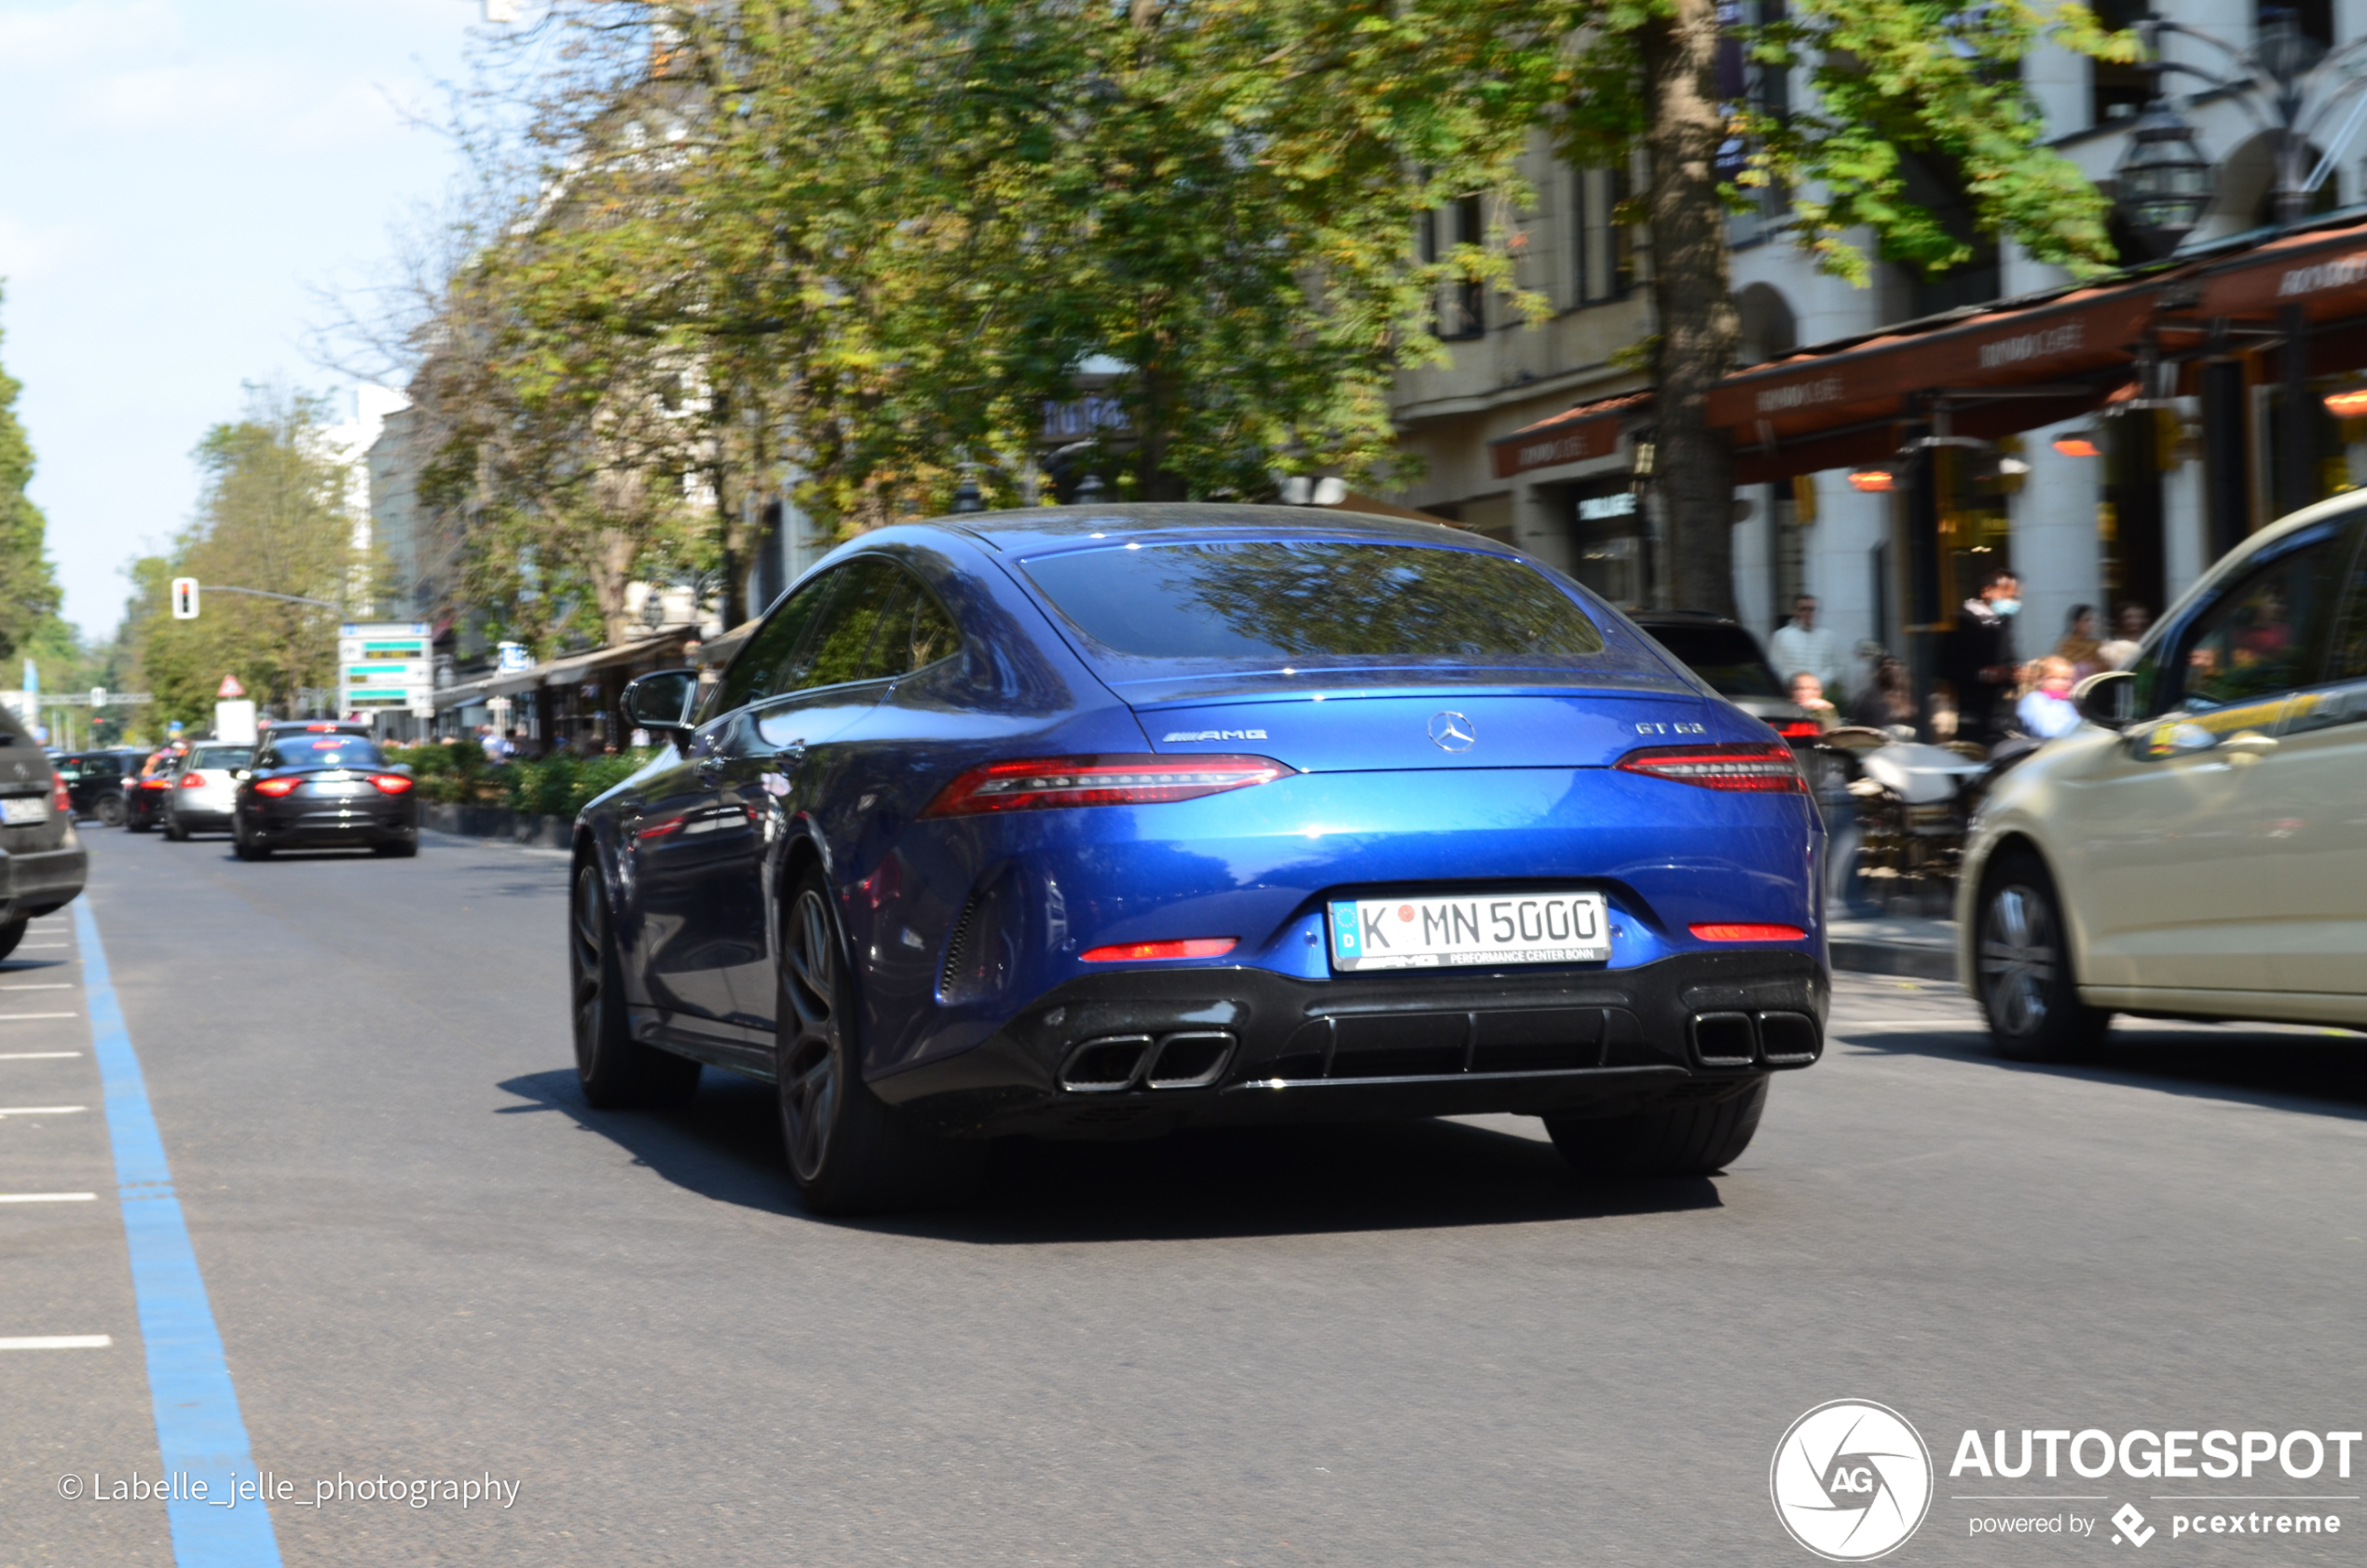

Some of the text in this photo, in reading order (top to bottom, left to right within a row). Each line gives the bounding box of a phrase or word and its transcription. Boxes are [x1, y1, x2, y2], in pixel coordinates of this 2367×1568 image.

[1193, 729, 1268, 742] AMG
[1635, 722, 1706, 735] GT 63
[1362, 899, 1597, 948] K MN 5000
[1343, 933, 1355, 948] D
[1381, 948, 1594, 969] AMG PERFORMANCE CENTER BONN
